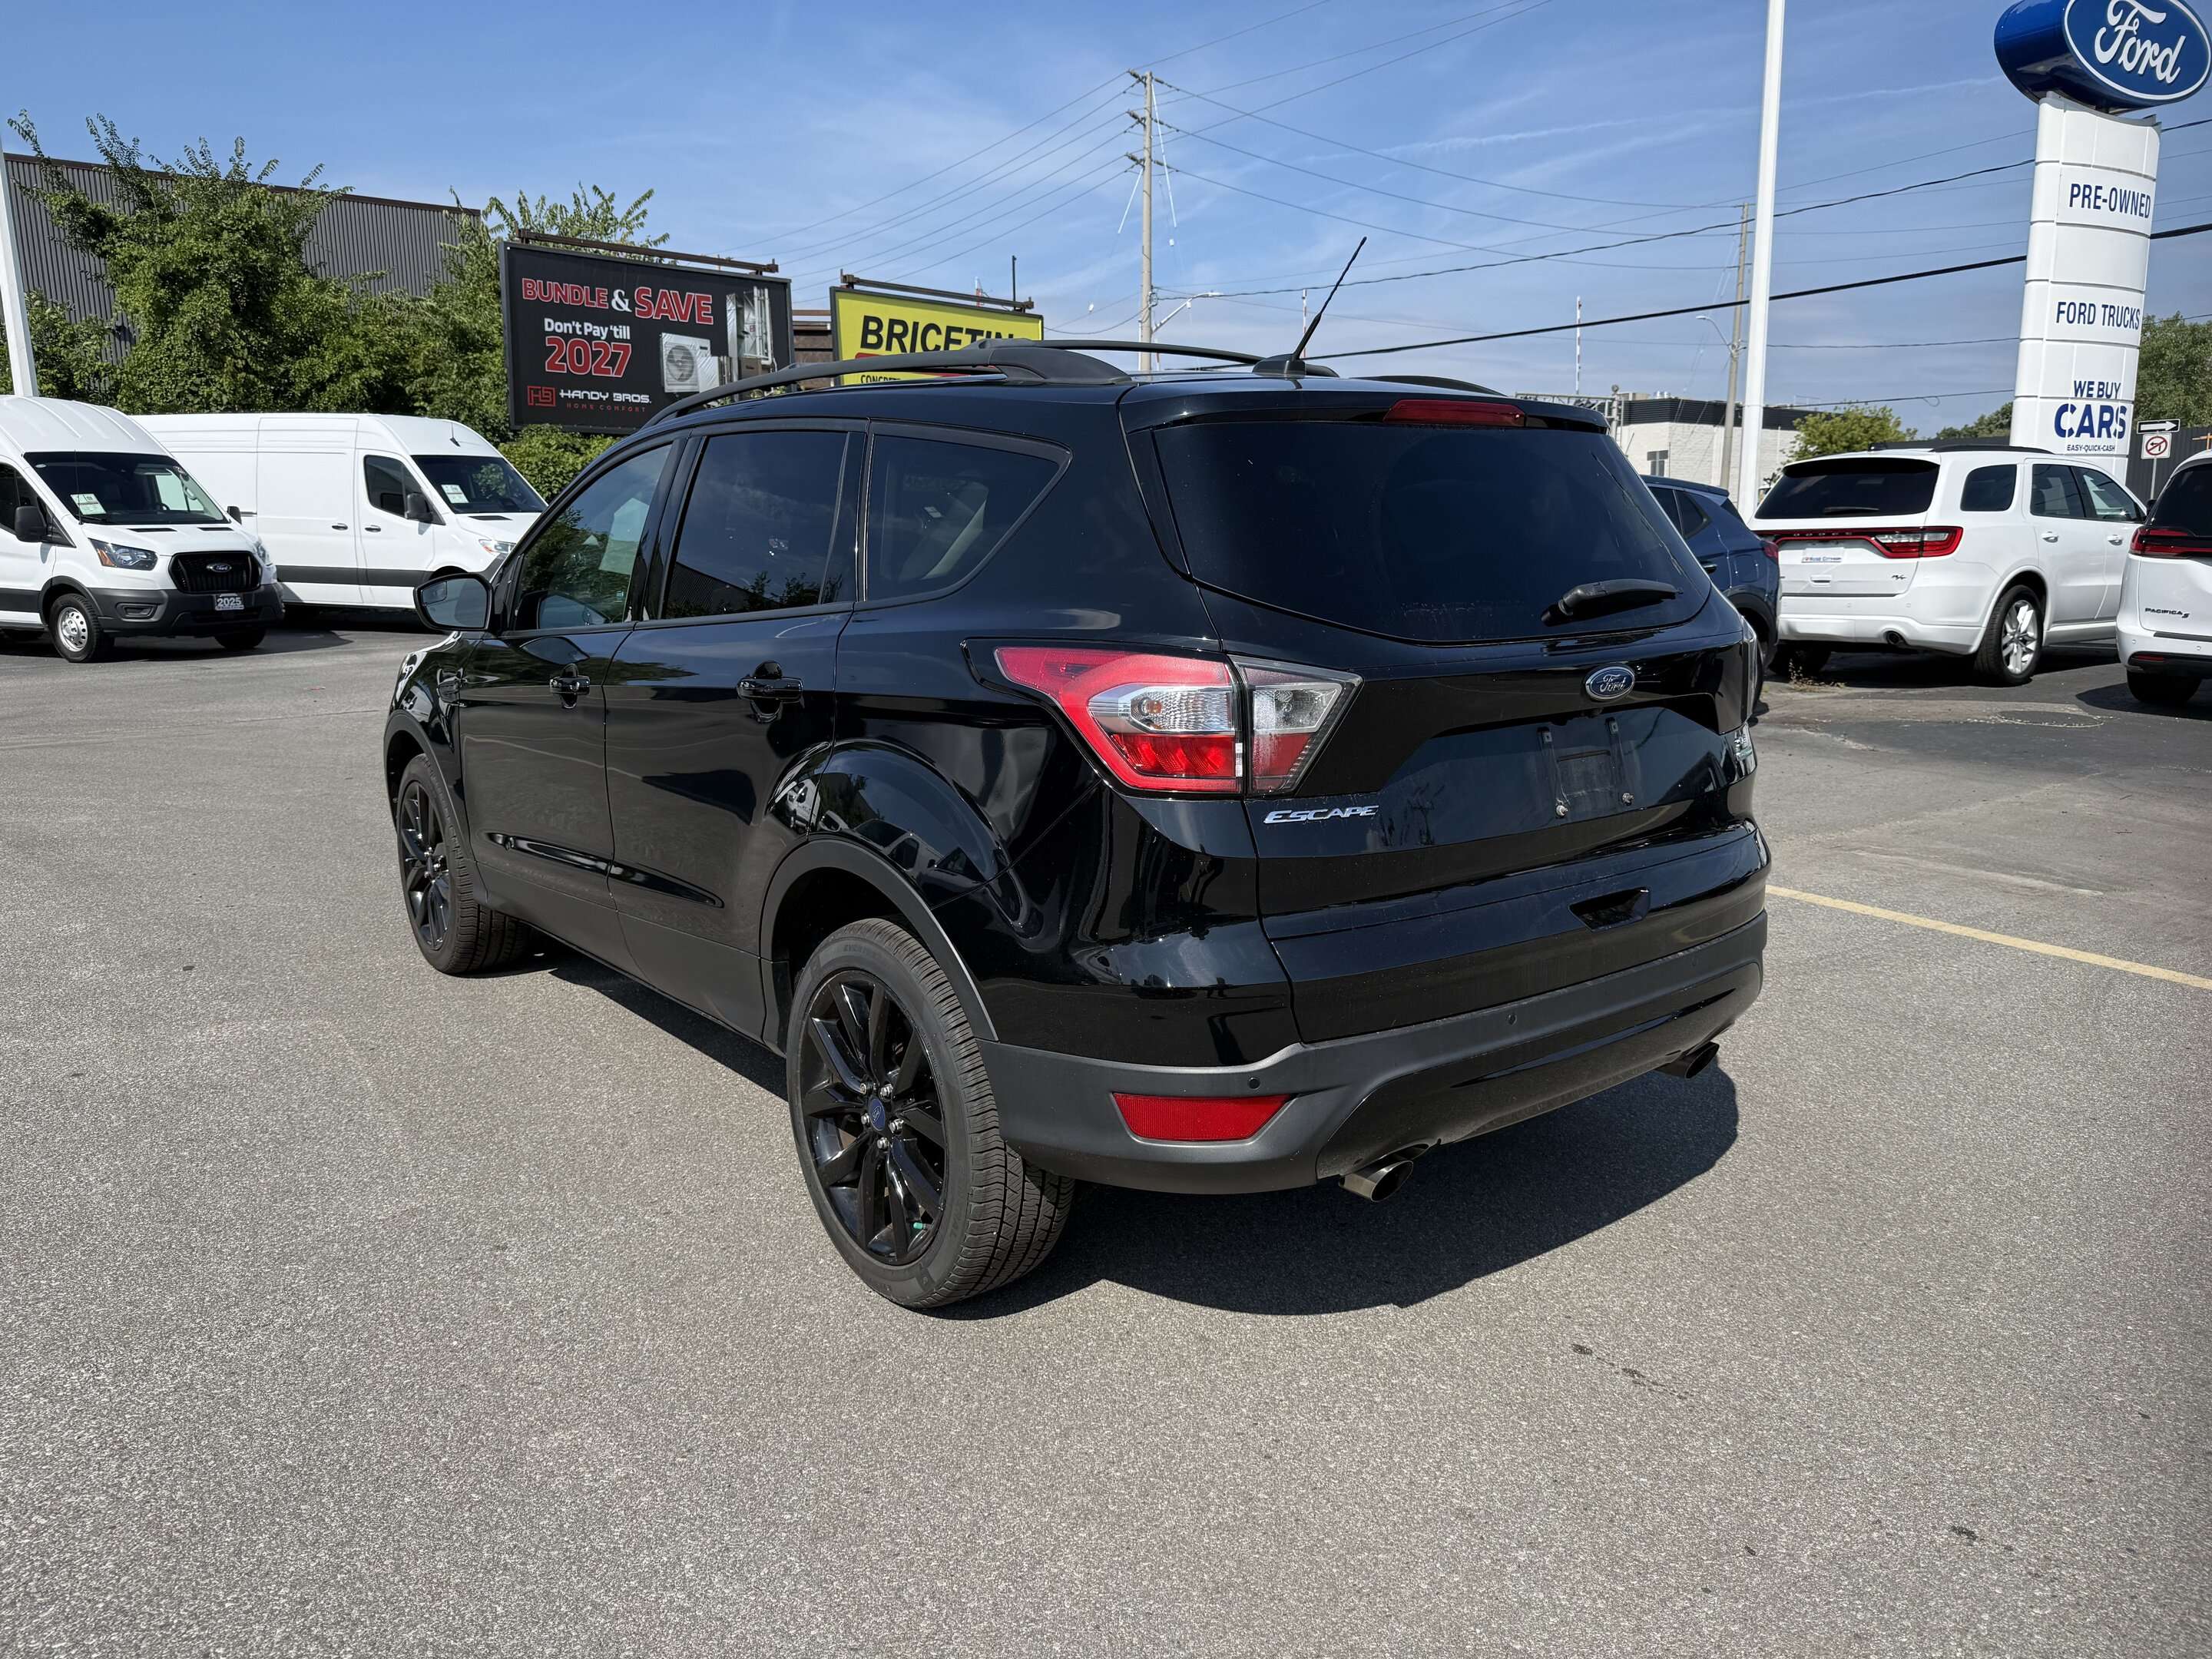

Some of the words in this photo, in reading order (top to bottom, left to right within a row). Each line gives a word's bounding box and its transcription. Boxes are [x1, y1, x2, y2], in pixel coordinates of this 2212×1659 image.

[2094, 0, 2186, 84] Ford
[2068, 183, 2151, 219] PRE-OWNED
[522, 277, 609, 310] BUNDLE
[611, 289, 632, 313] &
[634, 286, 714, 325] SAVE
[2056, 301, 2097, 325] FORD
[2101, 303, 2141, 330] TRUCKS
[544, 317, 582, 336] Don't
[584, 322, 608, 341] Pay
[545, 336, 632, 378] 2027
[559, 389, 609, 401] HANDY
[613, 392, 652, 404] BROS.
[2074, 380, 2095, 398] WE
[2097, 381, 2121, 399] BUY
[565, 402, 594, 411] HOME
[599, 403, 646, 412] COMFORT
[2054, 403, 2128, 439] CARS
[2067, 444, 2115, 452] EASY-QUICK-CASH
[217, 597, 242, 607] 2025
[1599, 673, 1625, 693] Ford
[1263, 805, 1379, 824] ESCAPE
